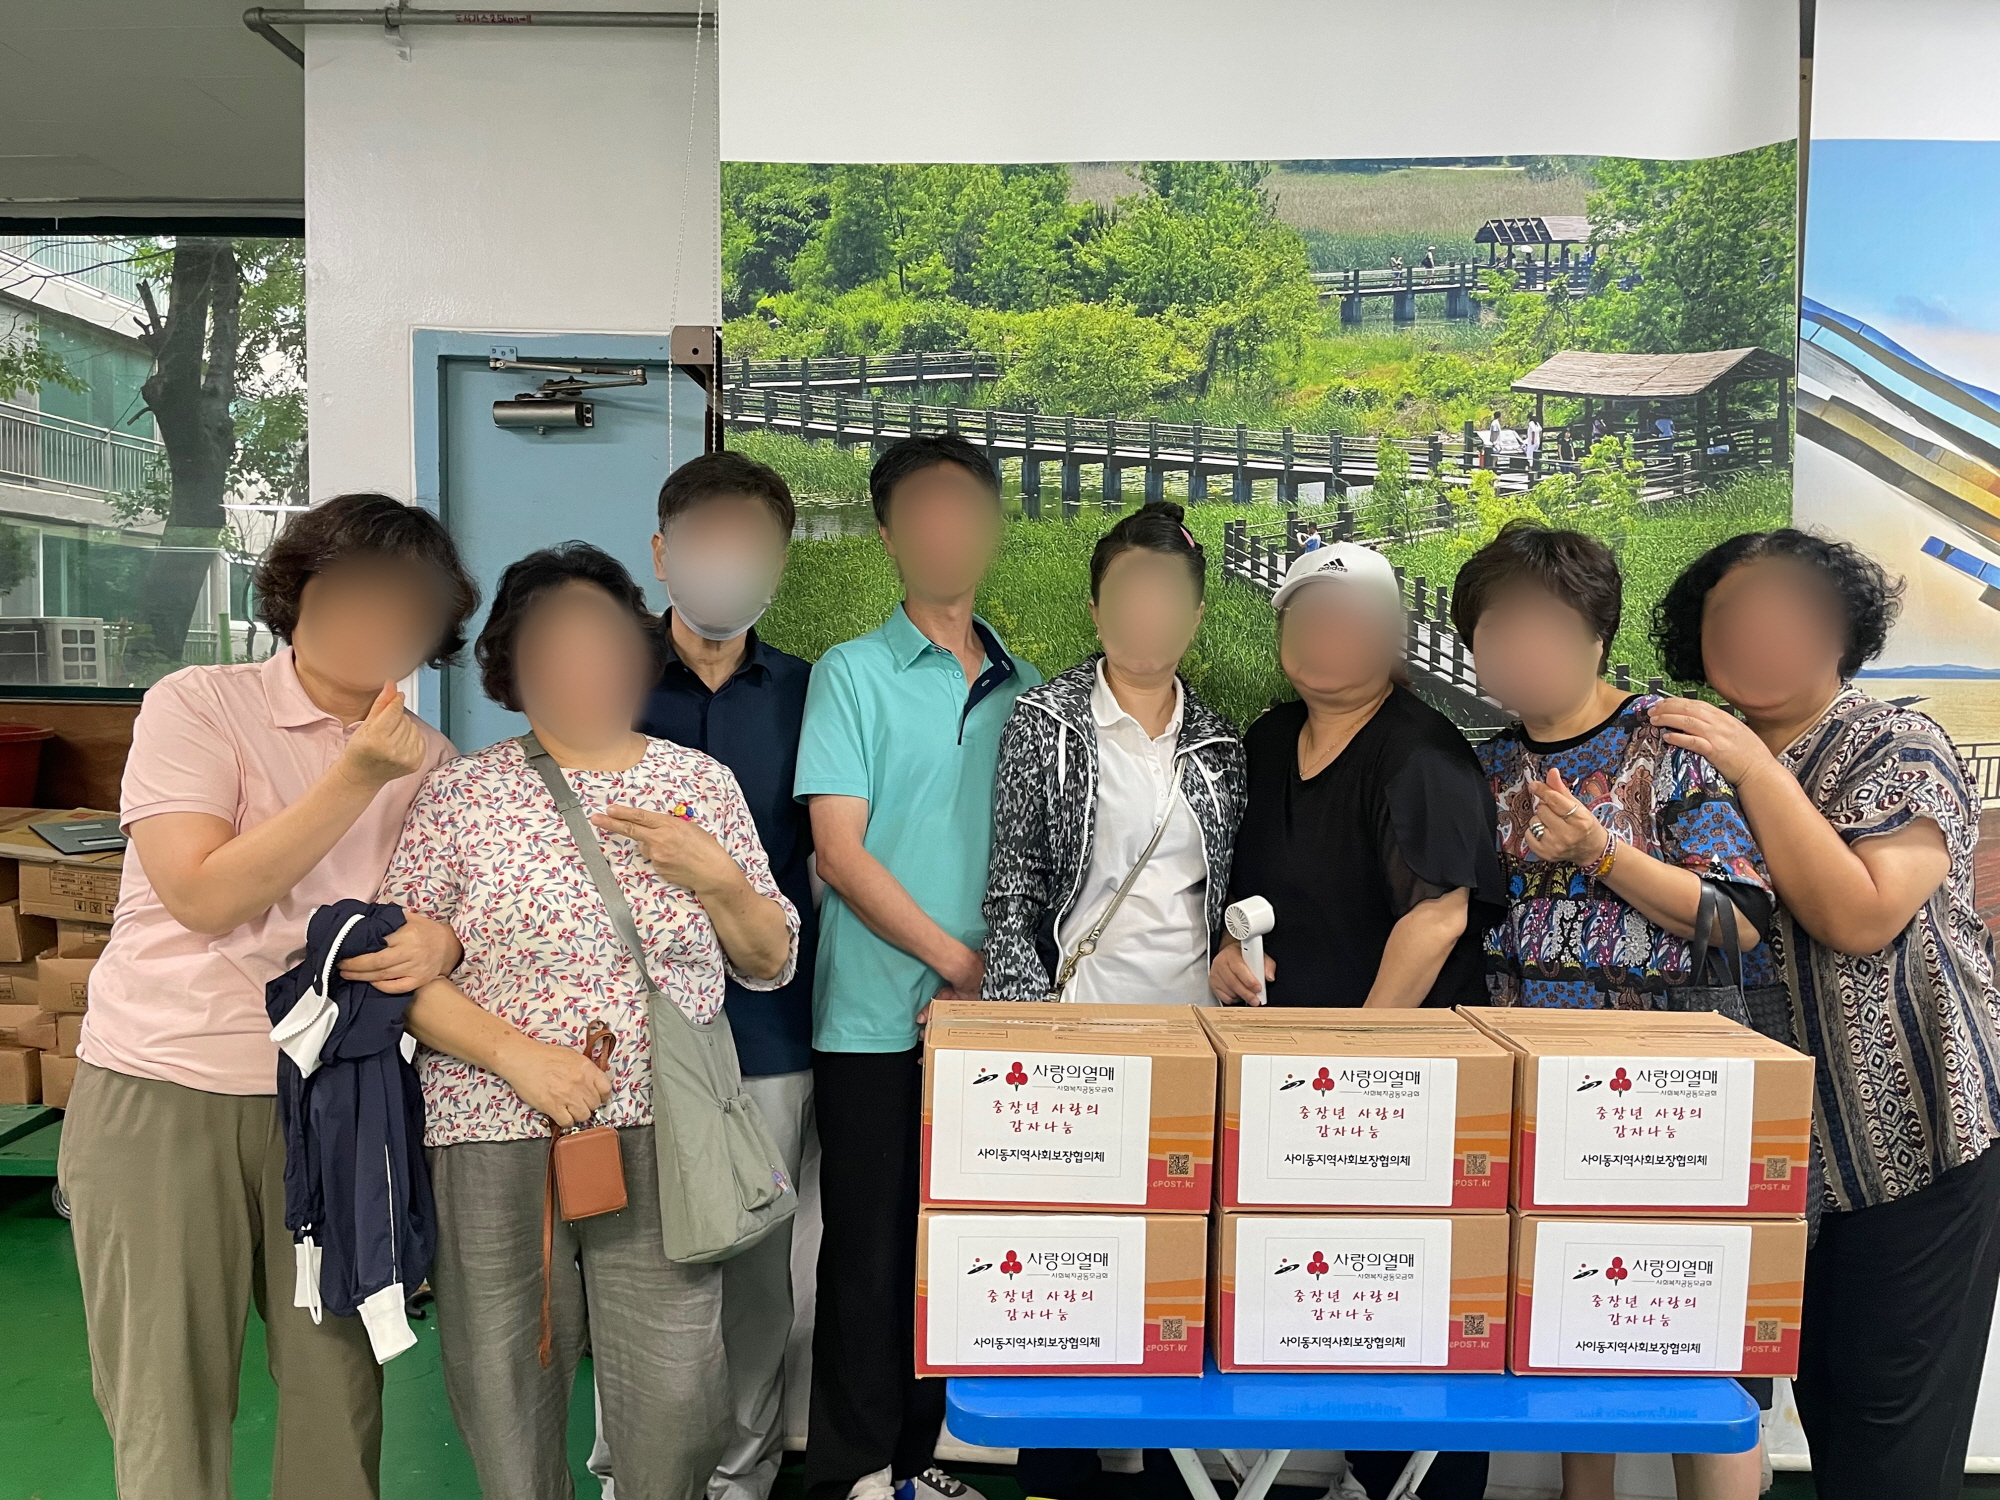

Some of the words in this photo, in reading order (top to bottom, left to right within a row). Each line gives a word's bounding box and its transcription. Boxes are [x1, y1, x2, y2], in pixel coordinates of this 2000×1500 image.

[1317, 565, 1349, 573] adidas
[1032, 1064, 1115, 1084] 사랑의열매
[1339, 1069, 1421, 1088] 사랑의열매
[1635, 1069, 1718, 1088] 사랑의열매
[992, 1100, 1040, 1115] 중장년
[1051, 1102, 1099, 1116] 사랑의
[1299, 1105, 1346, 1120] 중장년
[1358, 1107, 1405, 1121] 사랑의
[1596, 1106, 1644, 1121] 중장년
[1655, 1107, 1702, 1121] 사랑의
[1009, 1119, 1074, 1135] 감자나눔
[1316, 1124, 1379, 1139] 감자나눔
[1613, 1124, 1676, 1139] 감자나눔
[977, 1148, 1105, 1164] 사이동지역사회보장협의체
[1283, 1153, 1411, 1168] 사이동지역사회보장협의체
[1580, 1154, 1708, 1168] 사이동지역사회보장협의체
[1026, 1251, 1109, 1271] 사랑의열매
[1333, 1252, 1415, 1271] 사랑의열매
[1632, 1259, 1714, 1278] 사랑의열매
[986, 1289, 1035, 1303] 중장년
[1046, 1289, 1094, 1303] 사랑의
[1294, 1289, 1341, 1303] 중장년
[1353, 1289, 1400, 1304] 사랑의
[1591, 1294, 1639, 1309] 중장년
[1650, 1296, 1697, 1310] 사랑의
[1004, 1308, 1068, 1322] 감자나눔
[1311, 1308, 1374, 1322] 감자나눔
[1607, 1313, 1671, 1328] 감자나눔
[972, 1336, 1101, 1351] 사이동지역사회보장협의체
[1279, 1336, 1406, 1350] 사이동지역사회보장협의체
[1574, 1340, 1701, 1356] 사이동지역사회보장협의체
